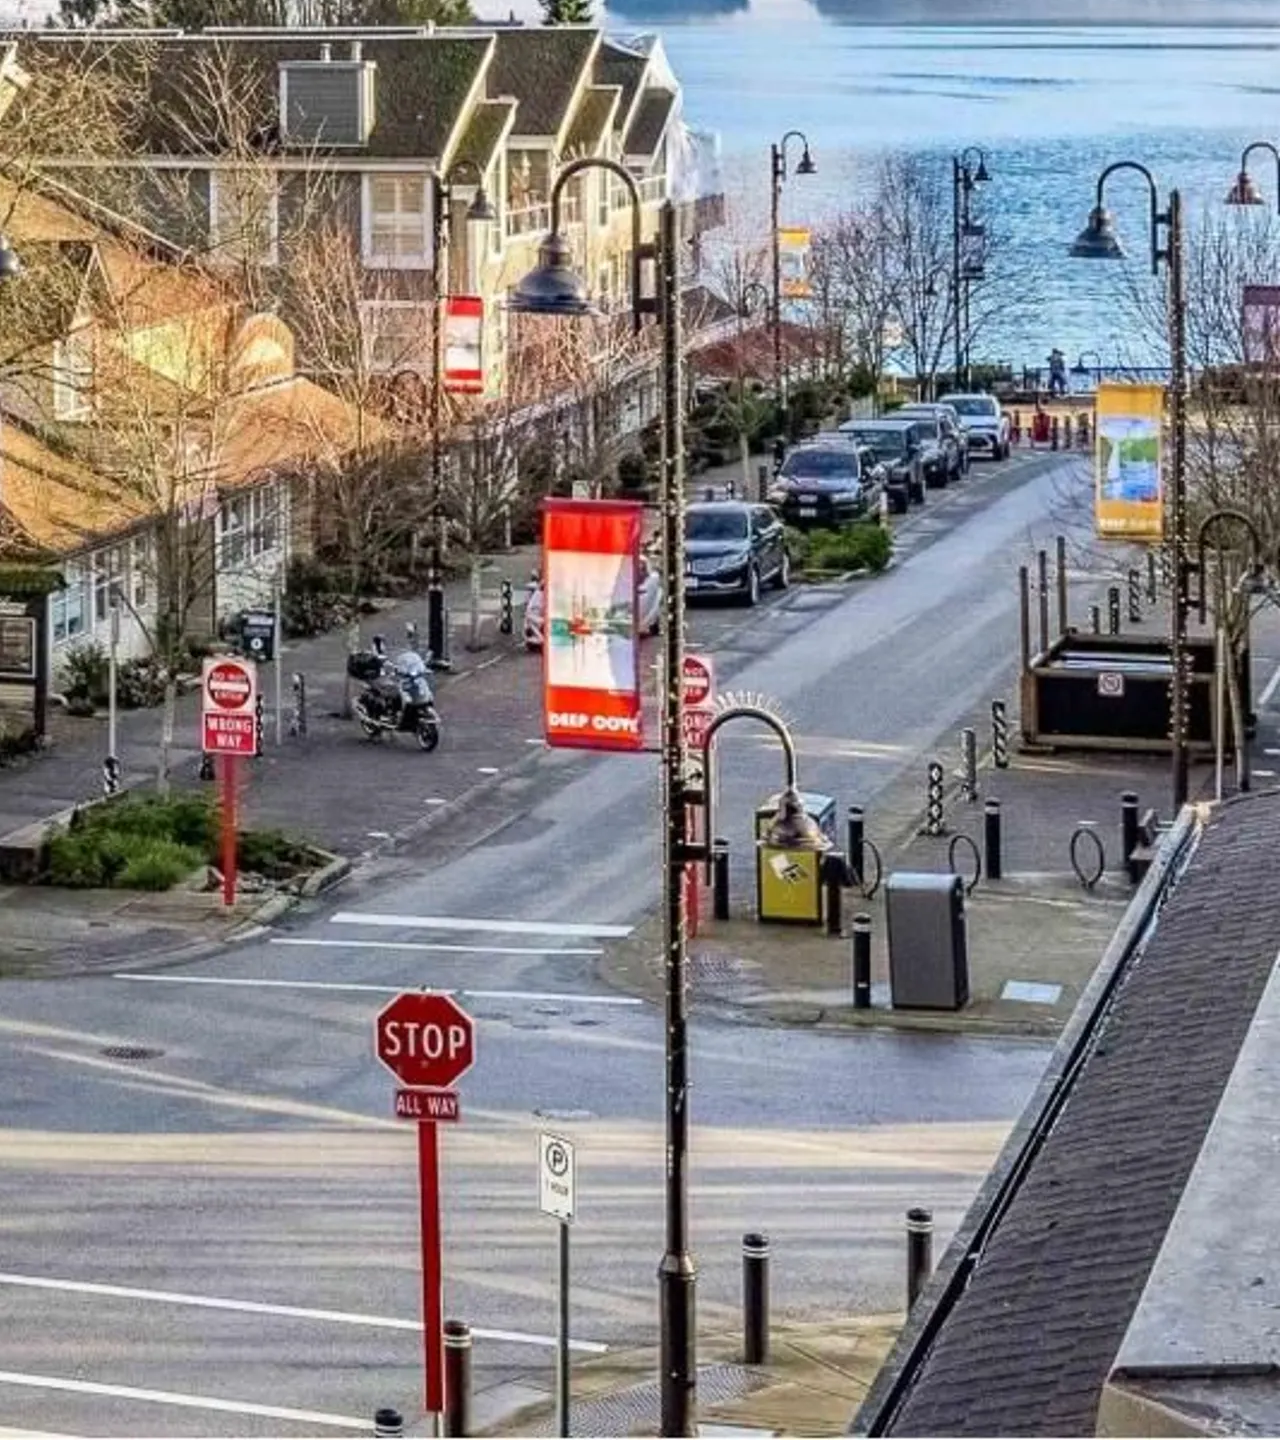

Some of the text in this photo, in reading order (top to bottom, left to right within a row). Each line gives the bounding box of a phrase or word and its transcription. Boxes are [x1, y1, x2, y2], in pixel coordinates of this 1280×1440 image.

[207, 715, 252, 734] WRONG
[548, 711, 590, 729] DEEP
[216, 733, 243, 748] WAY
[384, 1021, 466, 1059] STOP
[397, 1094, 457, 1116] ALL WAY
[552, 1149, 564, 1168] P
